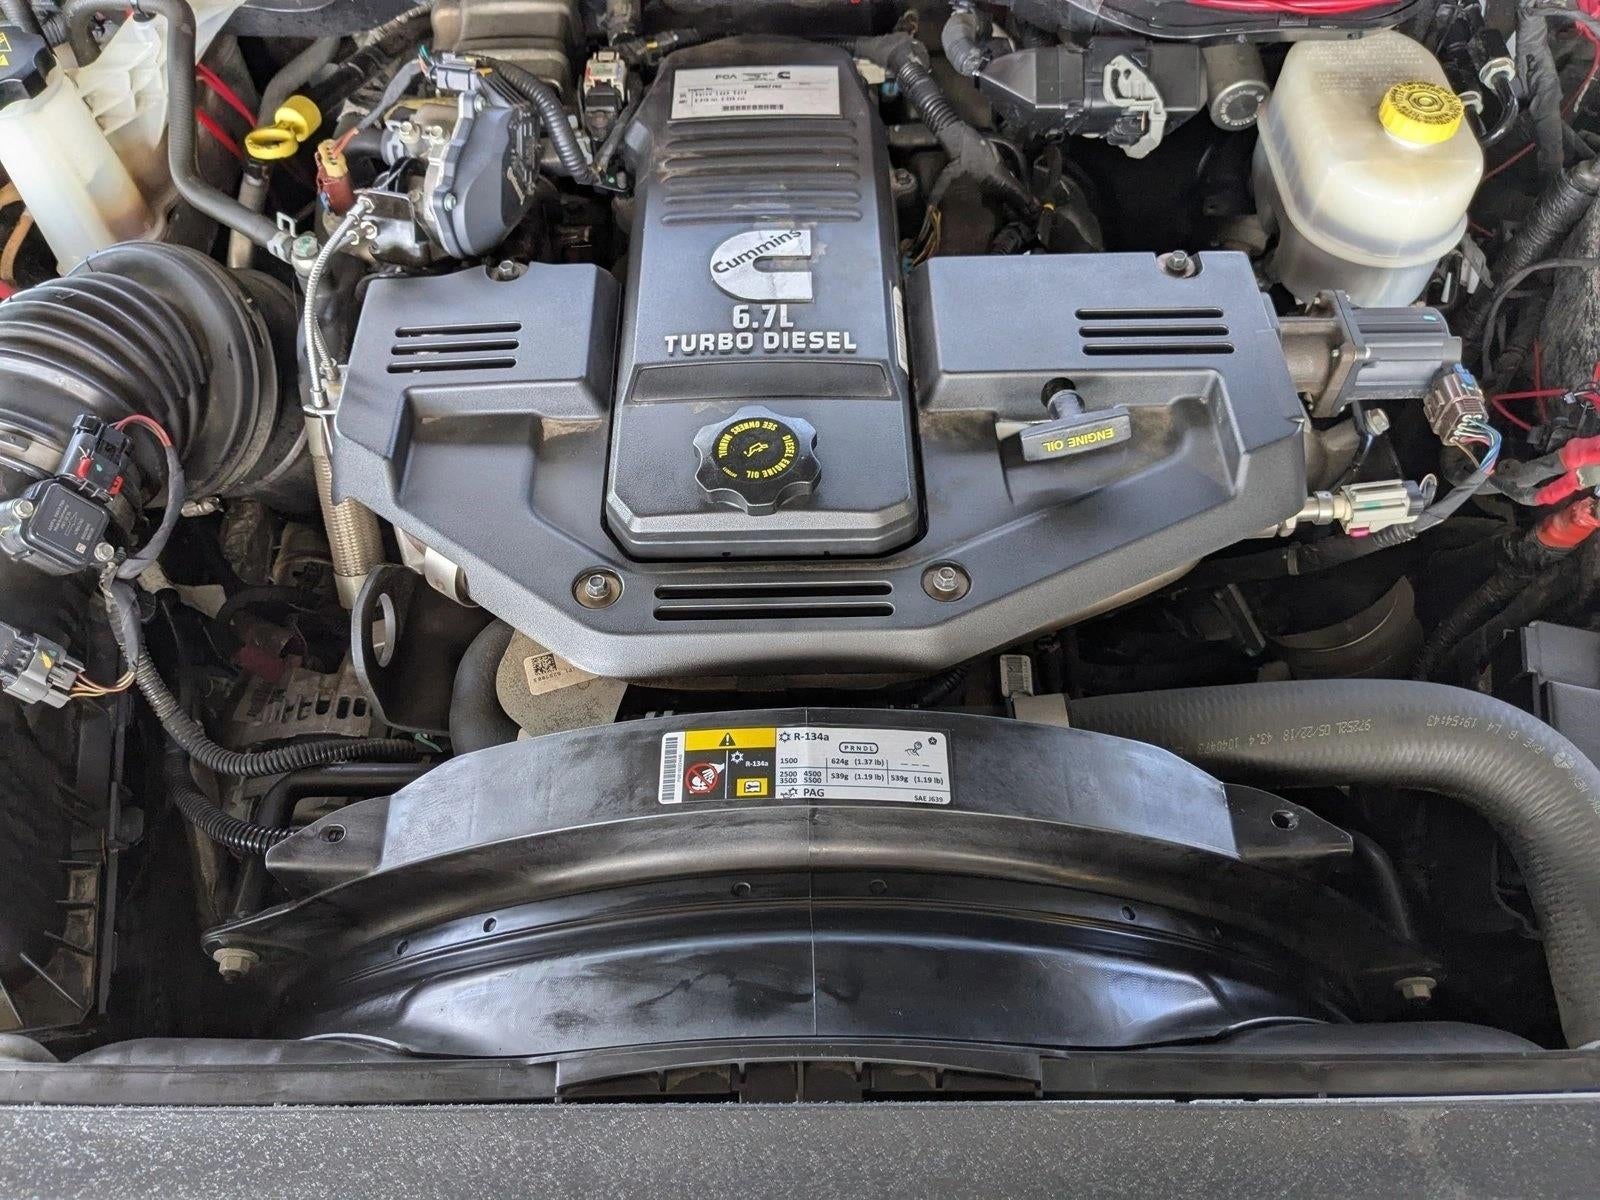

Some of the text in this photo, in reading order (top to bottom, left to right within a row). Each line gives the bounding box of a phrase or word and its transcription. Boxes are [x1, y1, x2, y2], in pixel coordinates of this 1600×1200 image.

[712, 228, 802, 273] Cummins
[732, 304, 794, 329] 6.7L
[664, 331, 857, 353] TURBO DIESEL
[718, 421, 778, 458] SEE OWNERS MANUAL
[782, 434, 795, 457] DIESEL
[1042, 427, 1114, 452] ENGINE OIL
[746, 470, 760, 479] OIL
[761, 458, 791, 478] ENGINE
[1335, 718, 1371, 734] 97252L
[1426, 715, 1478, 729] 19:54:43
[793, 732, 830, 741] R-134a
[1248, 732, 1272, 745] 43.4
[1282, 724, 1331, 742] 05/22/18
[831, 758, 884, 767] 624g (1.37 lb)
[831, 773, 849, 781] 539g
[874, 774, 884, 782] lb)
[891, 775, 944, 785] 539g (1.19 lb)
[803, 788, 825, 797] PAG
